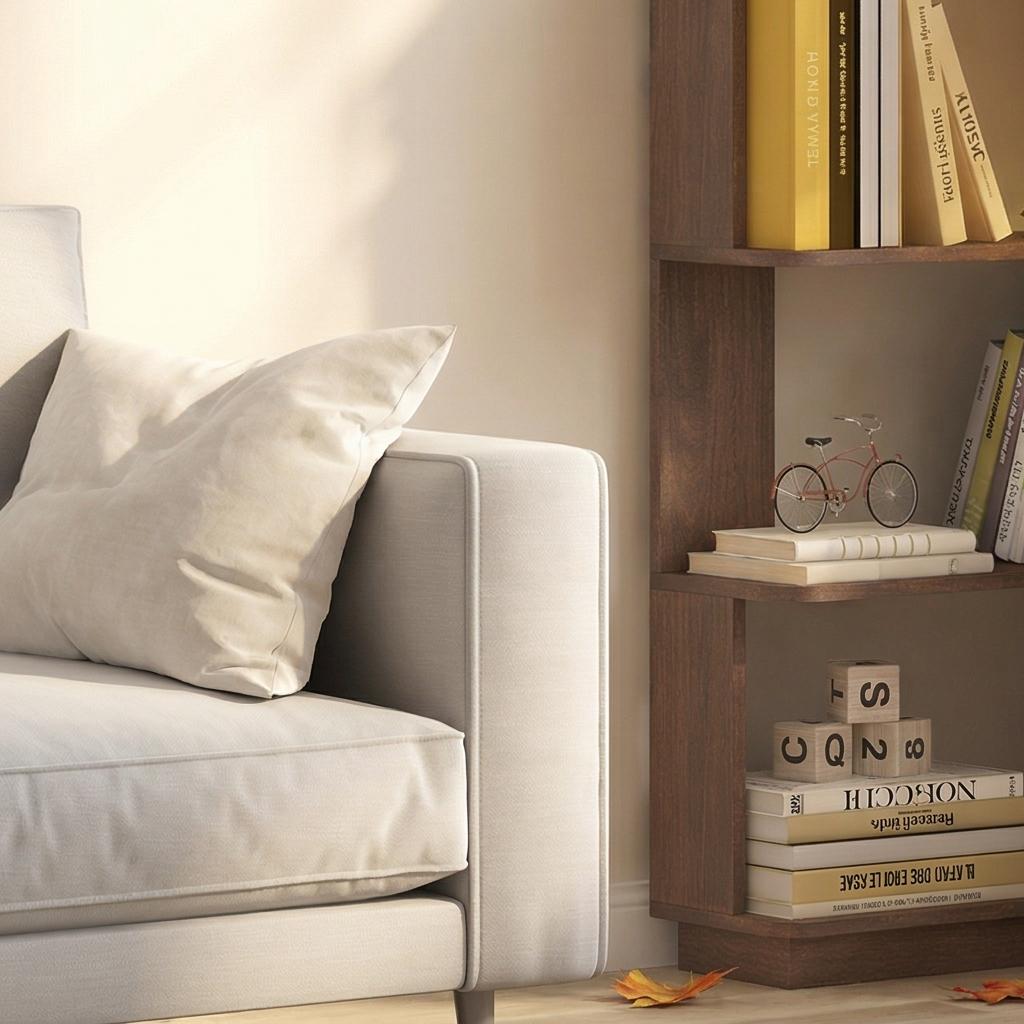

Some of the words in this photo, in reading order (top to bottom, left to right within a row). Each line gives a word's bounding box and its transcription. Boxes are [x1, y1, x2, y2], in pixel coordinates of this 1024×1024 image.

[831, 678, 844, 704] T
[860, 681, 890, 708] S
[781, 736, 808, 765] C
[824, 733, 845, 768] Q
[861, 736, 888, 761] 2
[905, 737, 925, 760] 8
